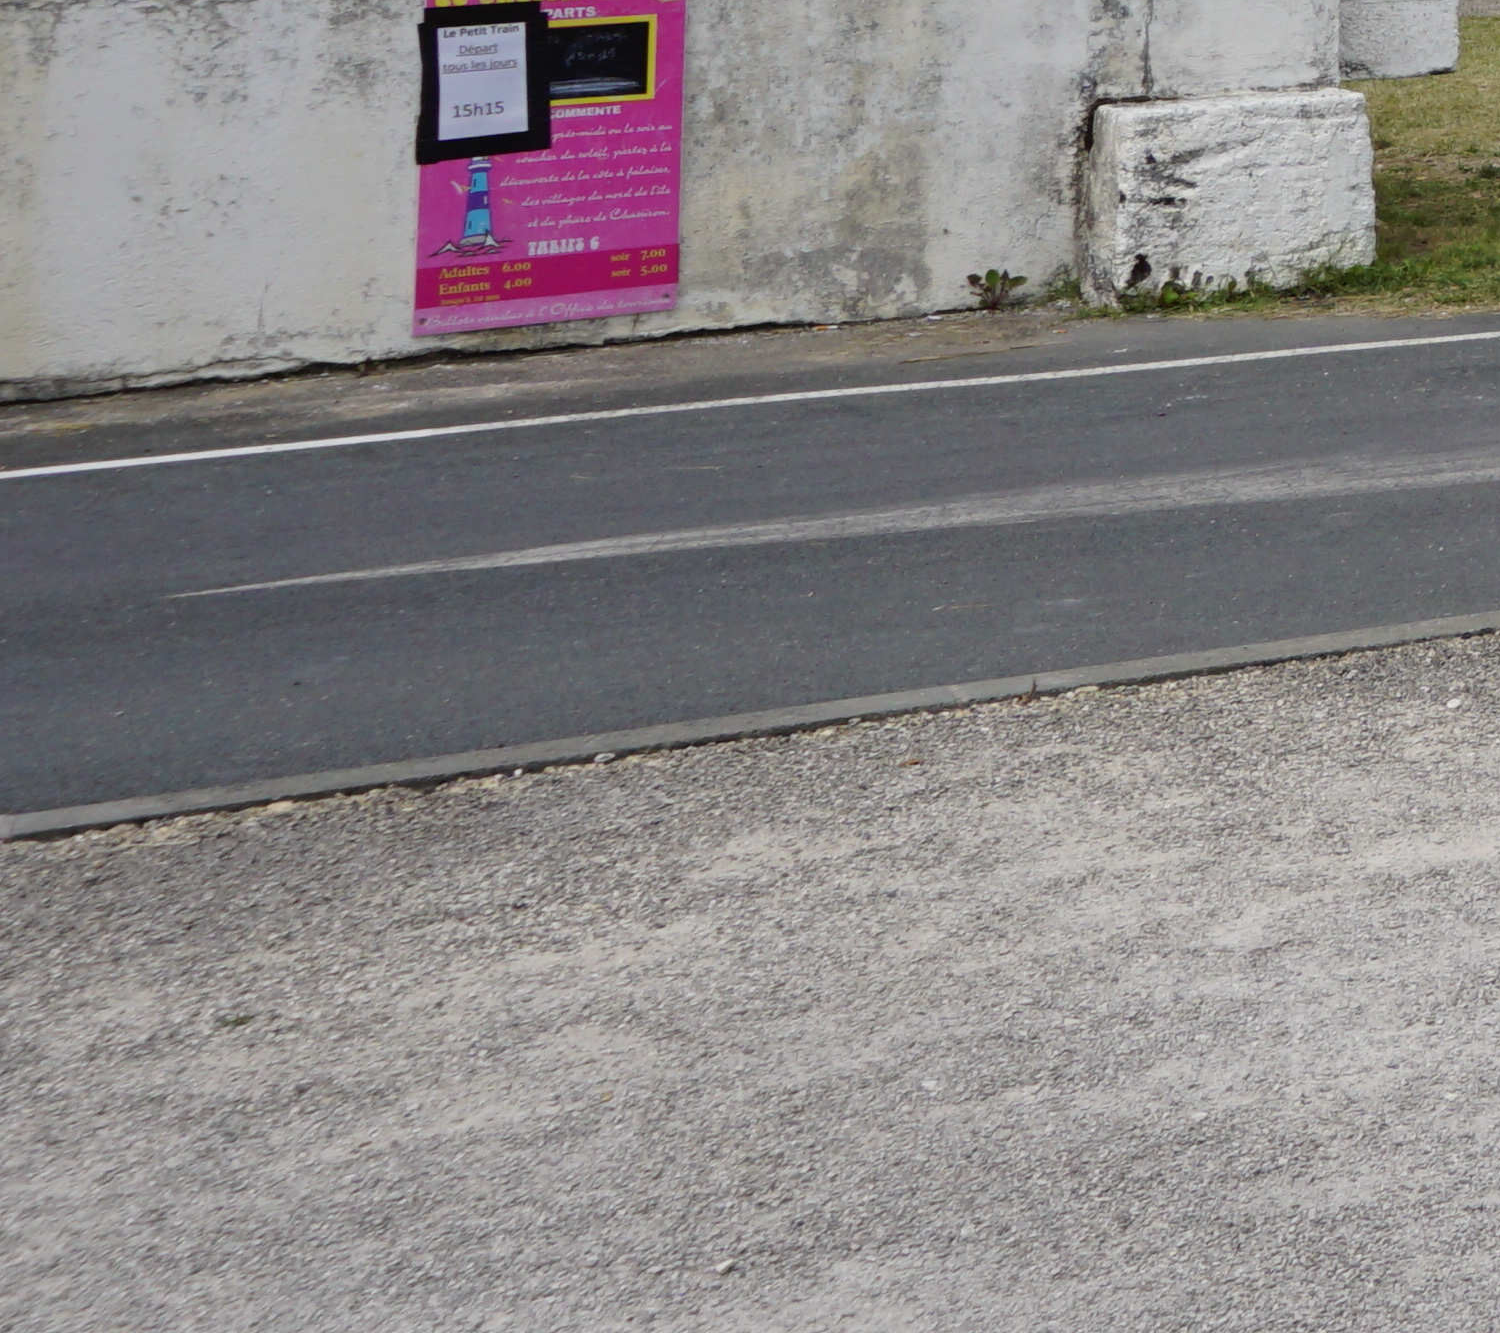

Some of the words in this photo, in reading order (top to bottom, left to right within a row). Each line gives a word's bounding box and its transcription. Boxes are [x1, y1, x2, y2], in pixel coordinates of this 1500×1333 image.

[540, 6, 596, 19] PARTS
[443, 30, 456, 39] Le
[460, 27, 487, 37] Petit
[490, 24, 519, 34] Train
[459, 43, 498, 56] Départ
[443, 63, 468, 72] tous
[471, 60, 487, 70] les
[489, 58, 518, 70] jours
[452, 100, 505, 119] 15h15
[438, 265, 490, 279] Adultes
[502, 262, 532, 273] 6.00
[640, 248, 666, 261] 7.00
[438, 281, 491, 295] Enfants
[503, 278, 532, 290] 4.00
[640, 264, 668, 277] 5.00
